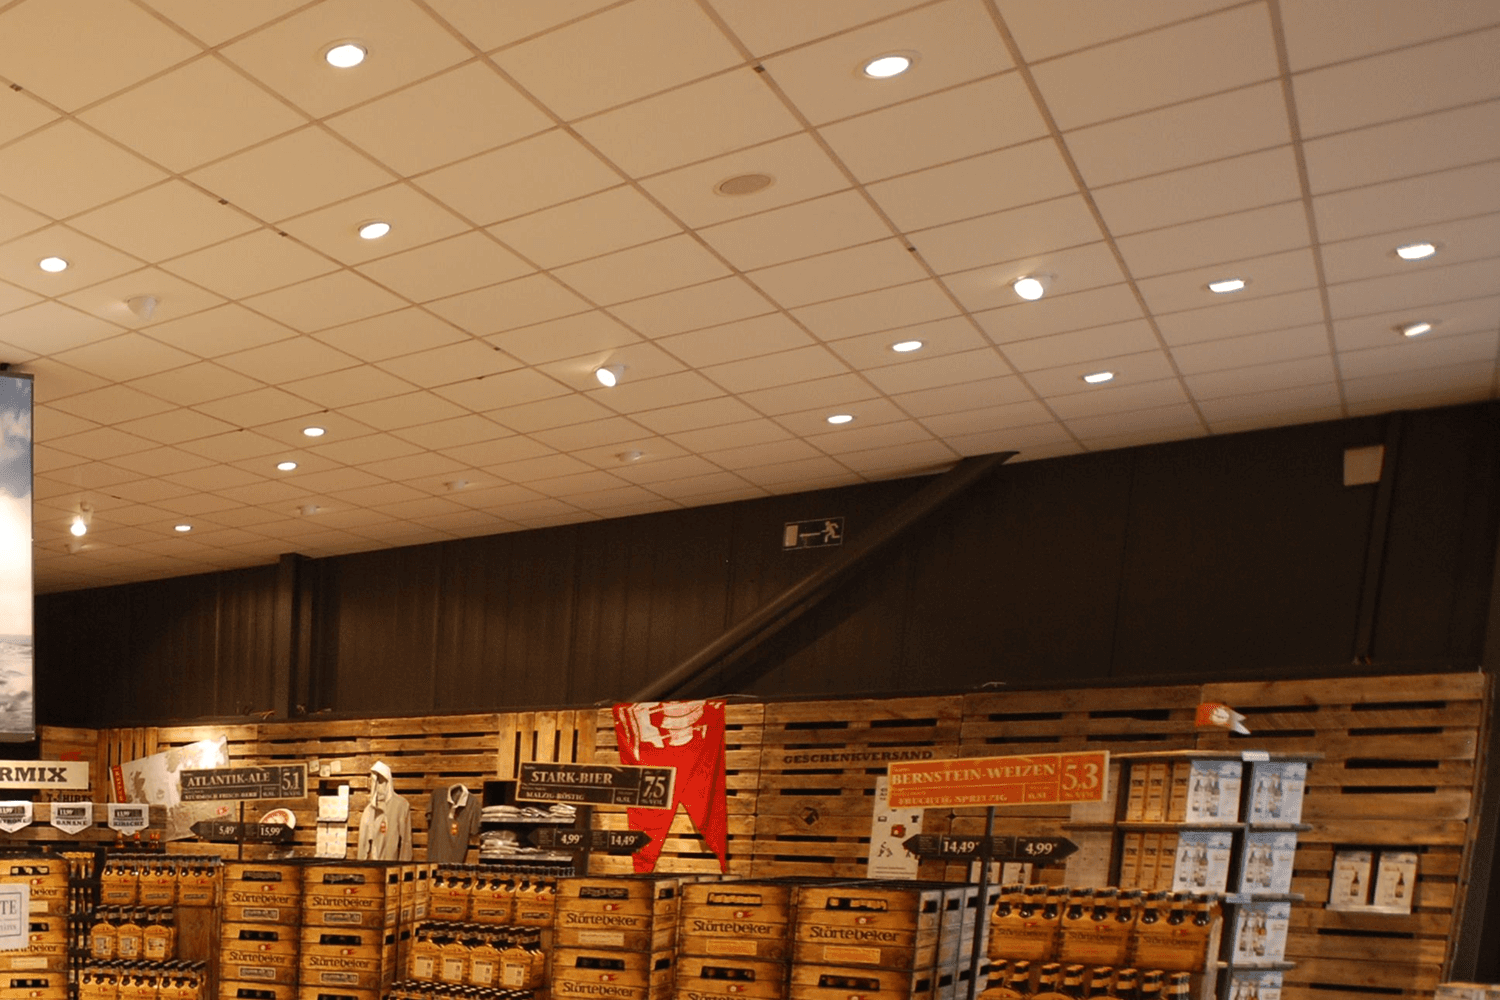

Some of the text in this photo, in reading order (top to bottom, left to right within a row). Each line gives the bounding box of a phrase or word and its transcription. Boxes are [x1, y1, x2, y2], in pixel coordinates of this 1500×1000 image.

[783, 750, 933, 765] GESCHENKVERSAND
[187, 771, 271, 787] ATLANTIK-ALE
[281, 772, 300, 791] 5,1
[531, 771, 613, 785] STARK-BIER
[891, 763, 1056, 786] BERNSTEIN-WEIZEN
[1062, 762, 1099, 791] 5,3
[643, 776, 666, 799] 7,5
[232, 892, 290, 905] Störtebeker
[312, 896, 373, 908] Störtebeker
[566, 912, 639, 927] Störtebeker
[692, 919, 773, 935] Störtebeker
[809, 925, 899, 942] Störtebeker
[229, 951, 286, 964] Störtebeker
[309, 956, 371, 969] Störtebeker
[562, 981, 636, 997] Störtebeker
